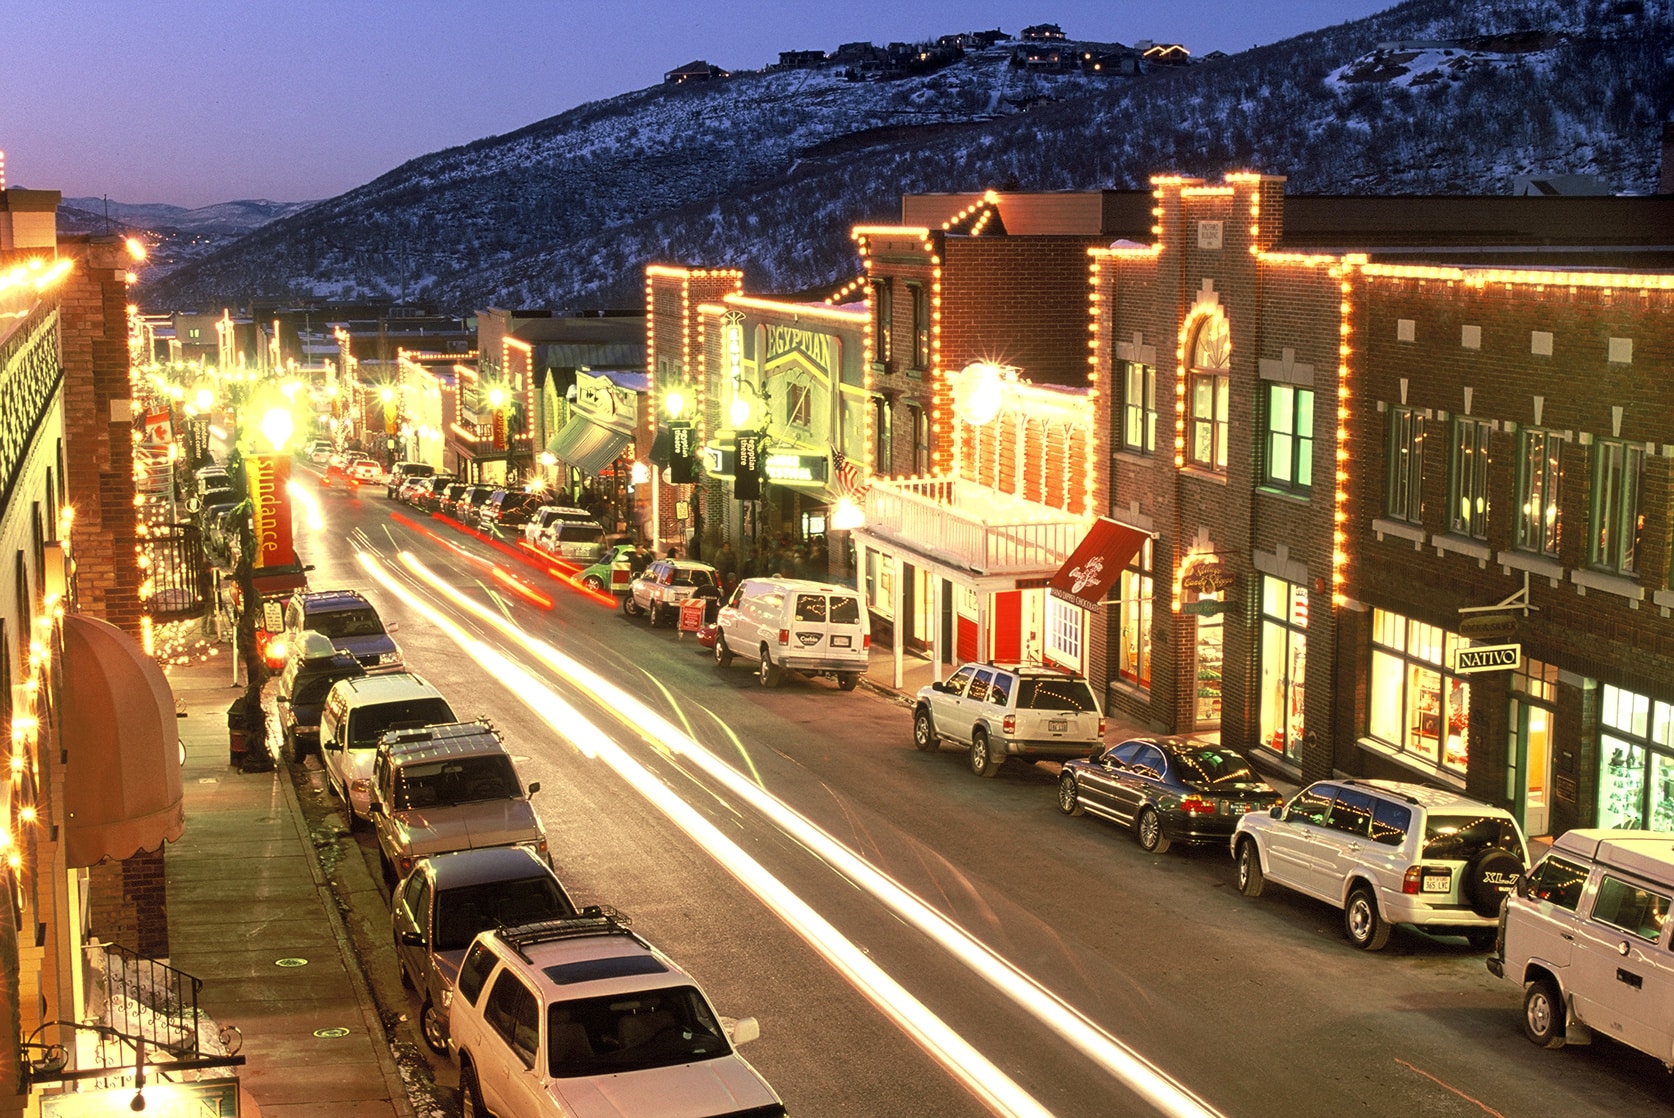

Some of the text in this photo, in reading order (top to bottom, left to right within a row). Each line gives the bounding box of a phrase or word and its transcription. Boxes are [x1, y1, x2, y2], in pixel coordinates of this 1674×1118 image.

[766, 324, 830, 370] EGYPTIAN
[681, 429, 689, 458] egyptian
[747, 439, 756, 471] egyptian
[259, 460, 282, 551] sundance
[1461, 650, 1515, 667] NATIVO
